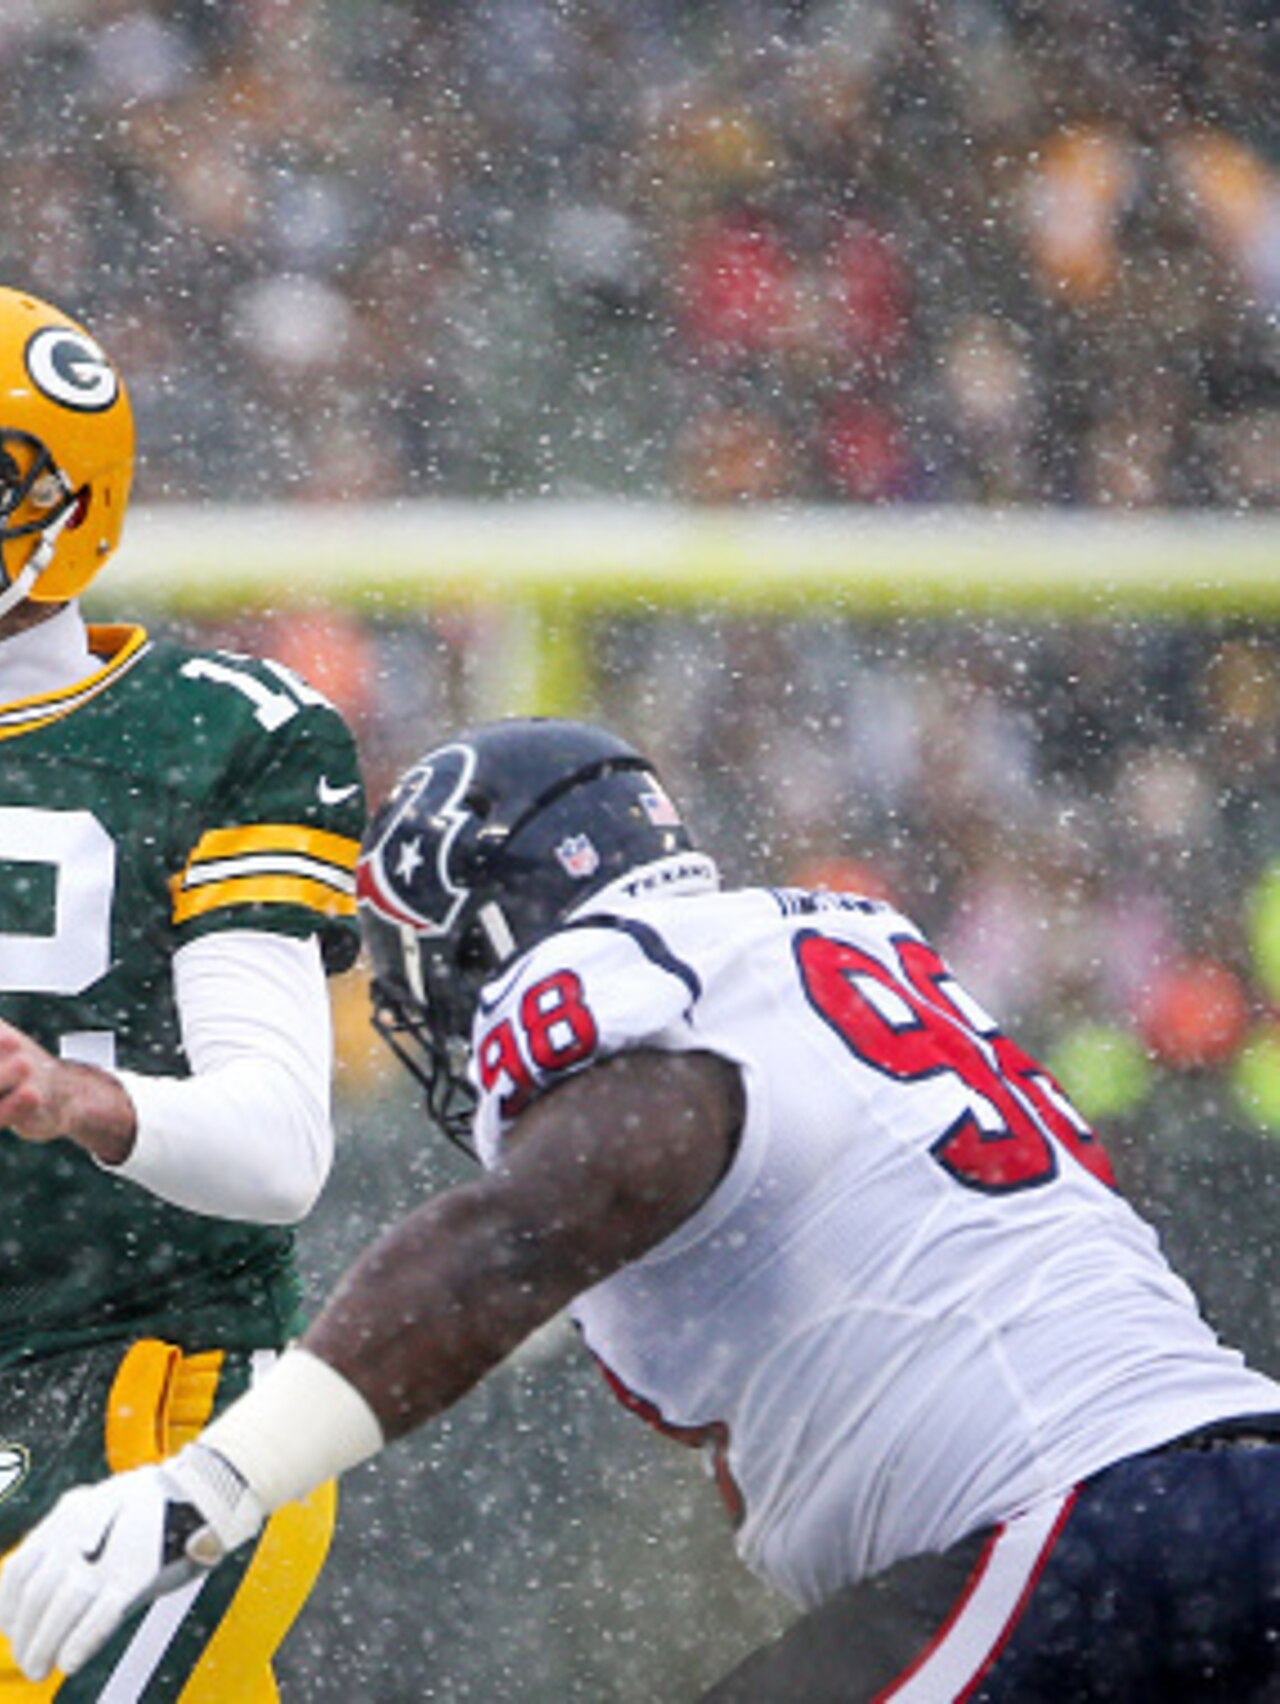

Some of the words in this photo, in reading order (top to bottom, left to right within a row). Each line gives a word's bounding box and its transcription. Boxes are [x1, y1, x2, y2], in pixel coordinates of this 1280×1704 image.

[27, 329, 117, 408] G
[479, 968, 600, 1117] 98
[792, 928, 1119, 1196] 98
